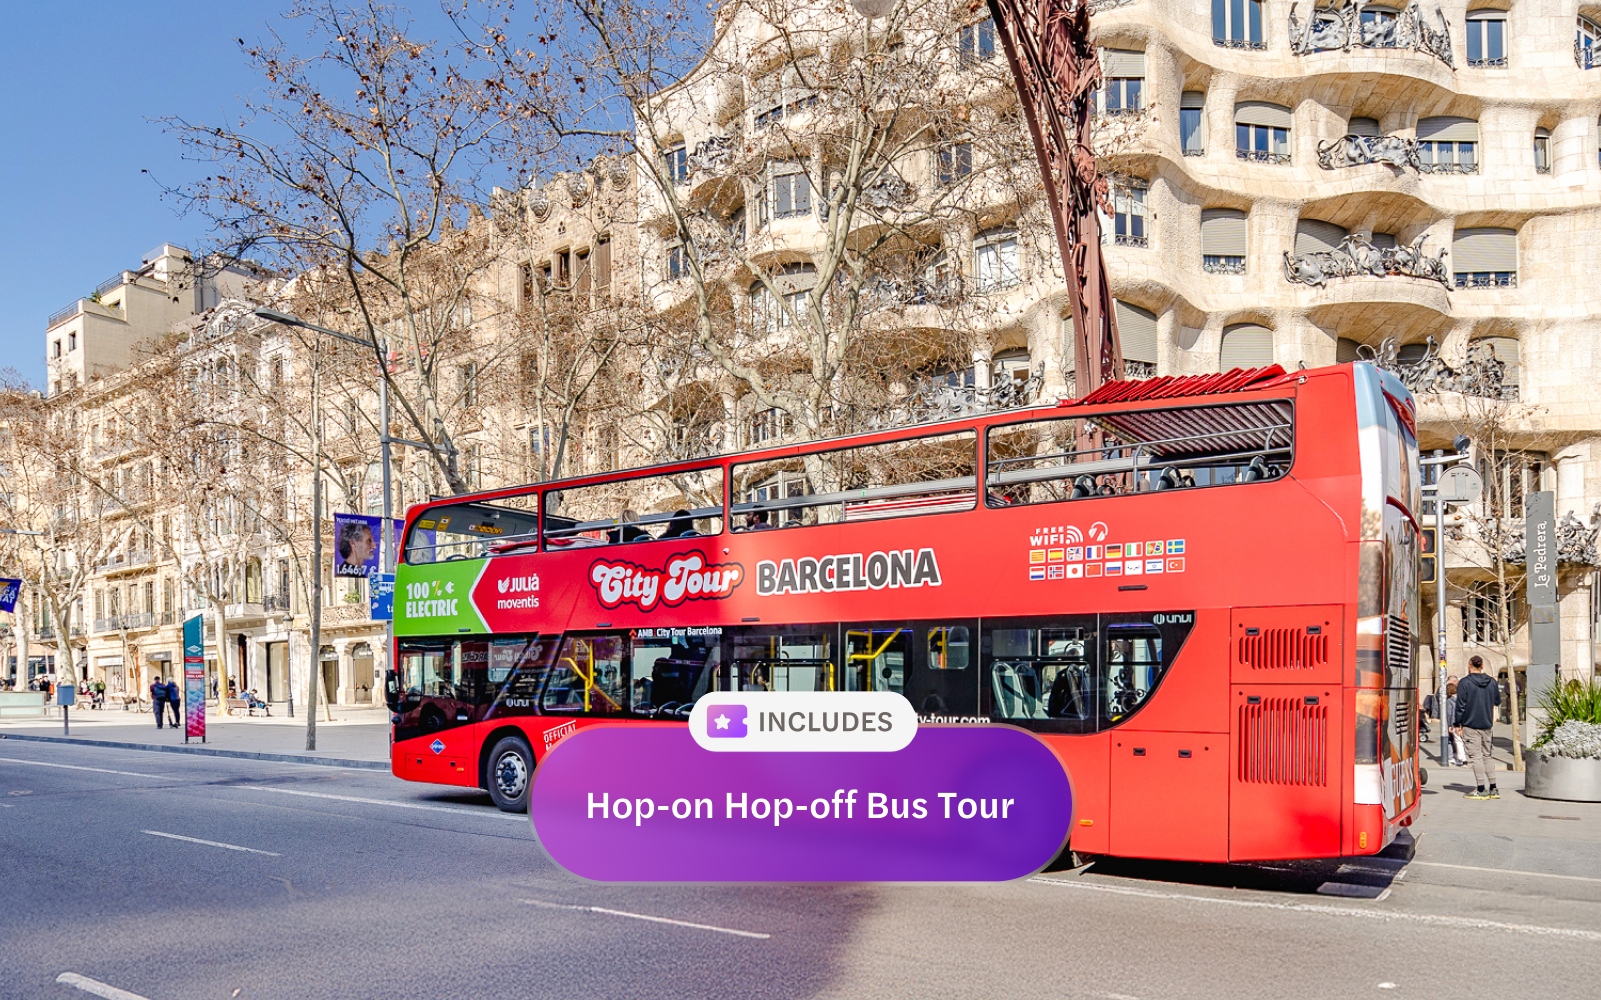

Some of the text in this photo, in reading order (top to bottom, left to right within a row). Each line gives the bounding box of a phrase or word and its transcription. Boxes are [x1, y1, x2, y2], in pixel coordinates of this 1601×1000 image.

[1036, 526, 1064, 534] FREE
[1029, 533, 1064, 546] WIFI
[1533, 520, 1550, 588] La Pedrera
[757, 548, 942, 596] BARCELONA
[592, 556, 740, 606] City Tour
[405, 598, 458, 618] ELECTRIC
[497, 595, 539, 610] moventis
[638, 625, 722, 639] AMB City Tour Barcelona
